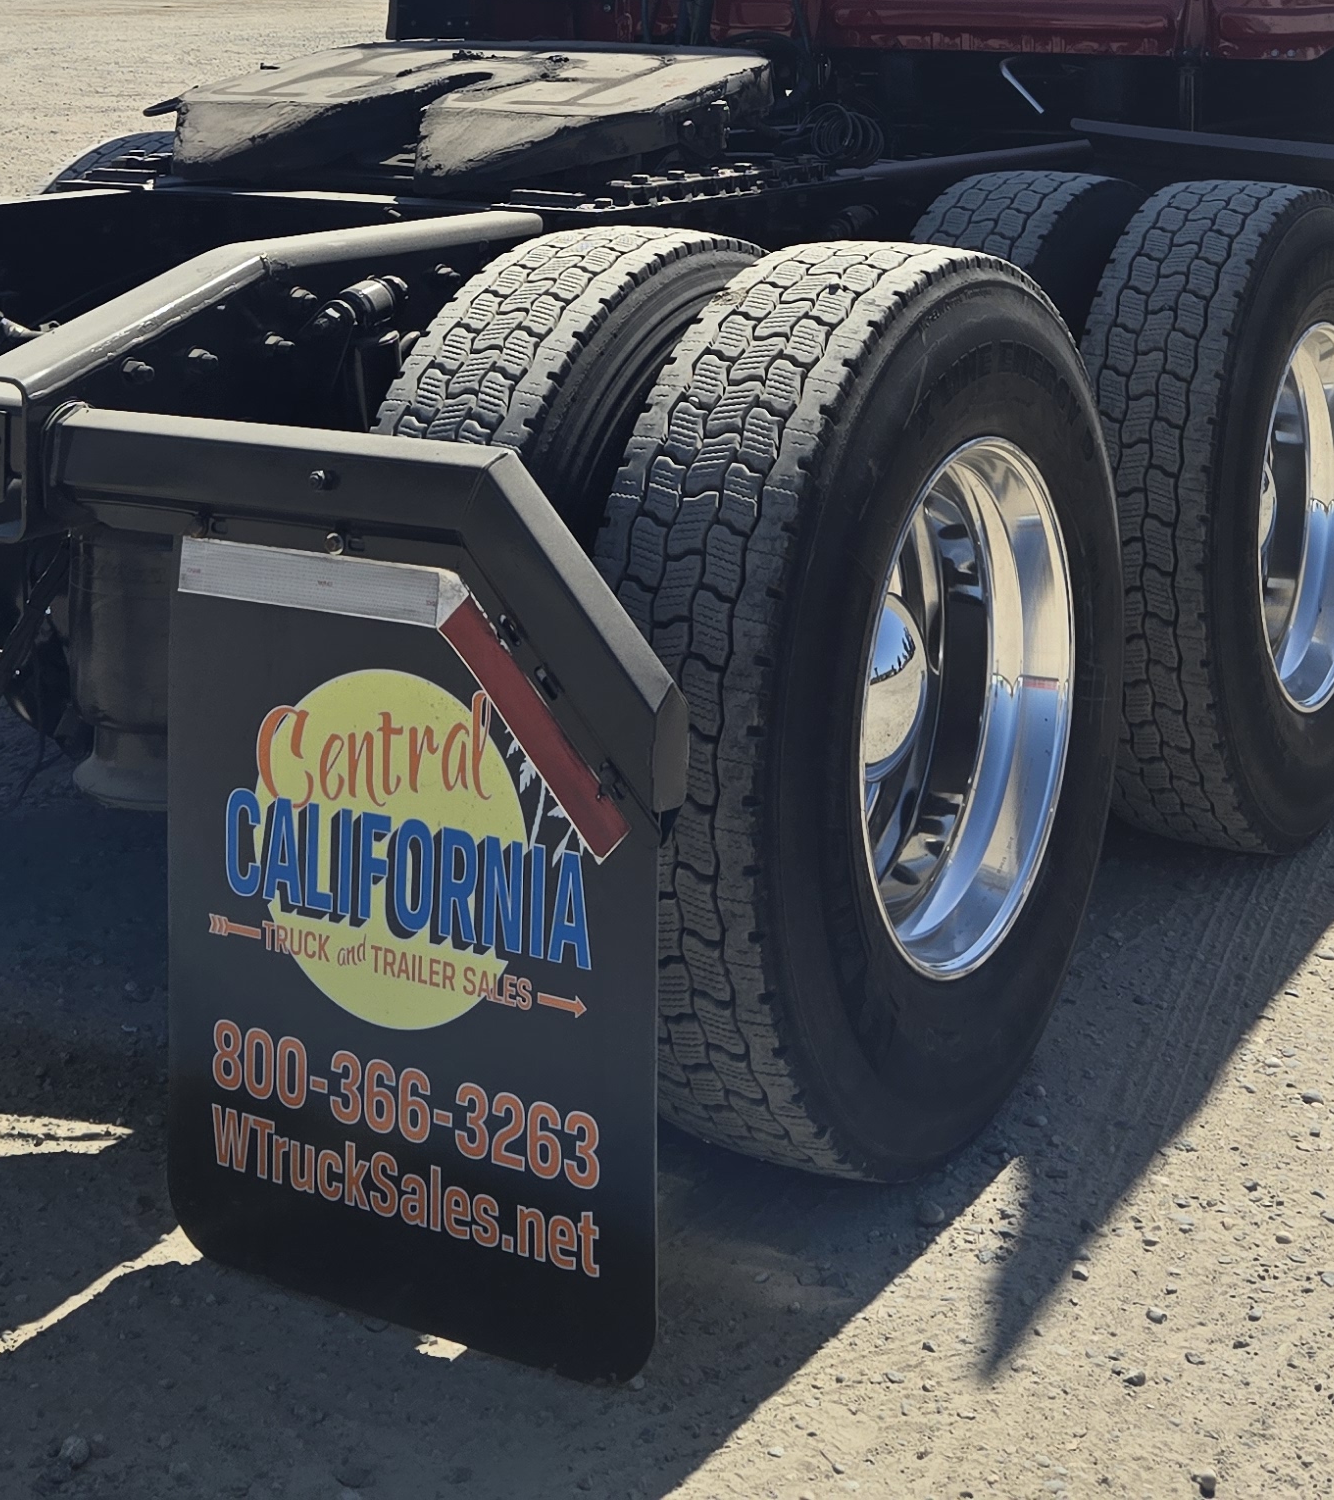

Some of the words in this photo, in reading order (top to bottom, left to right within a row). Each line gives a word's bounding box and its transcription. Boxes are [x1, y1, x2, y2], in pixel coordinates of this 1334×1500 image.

[257, 690, 492, 808] Central
[226, 788, 591, 970] CALIFORNIA
[262, 920, 331, 962] TRUCK
[337, 934, 367, 967] and
[371, 944, 456, 992] TRAILER
[462, 966, 533, 1010] SALES
[212, 1019, 600, 1190] 800-366-3263
[212, 1103, 600, 1278] WTruckSales.net
